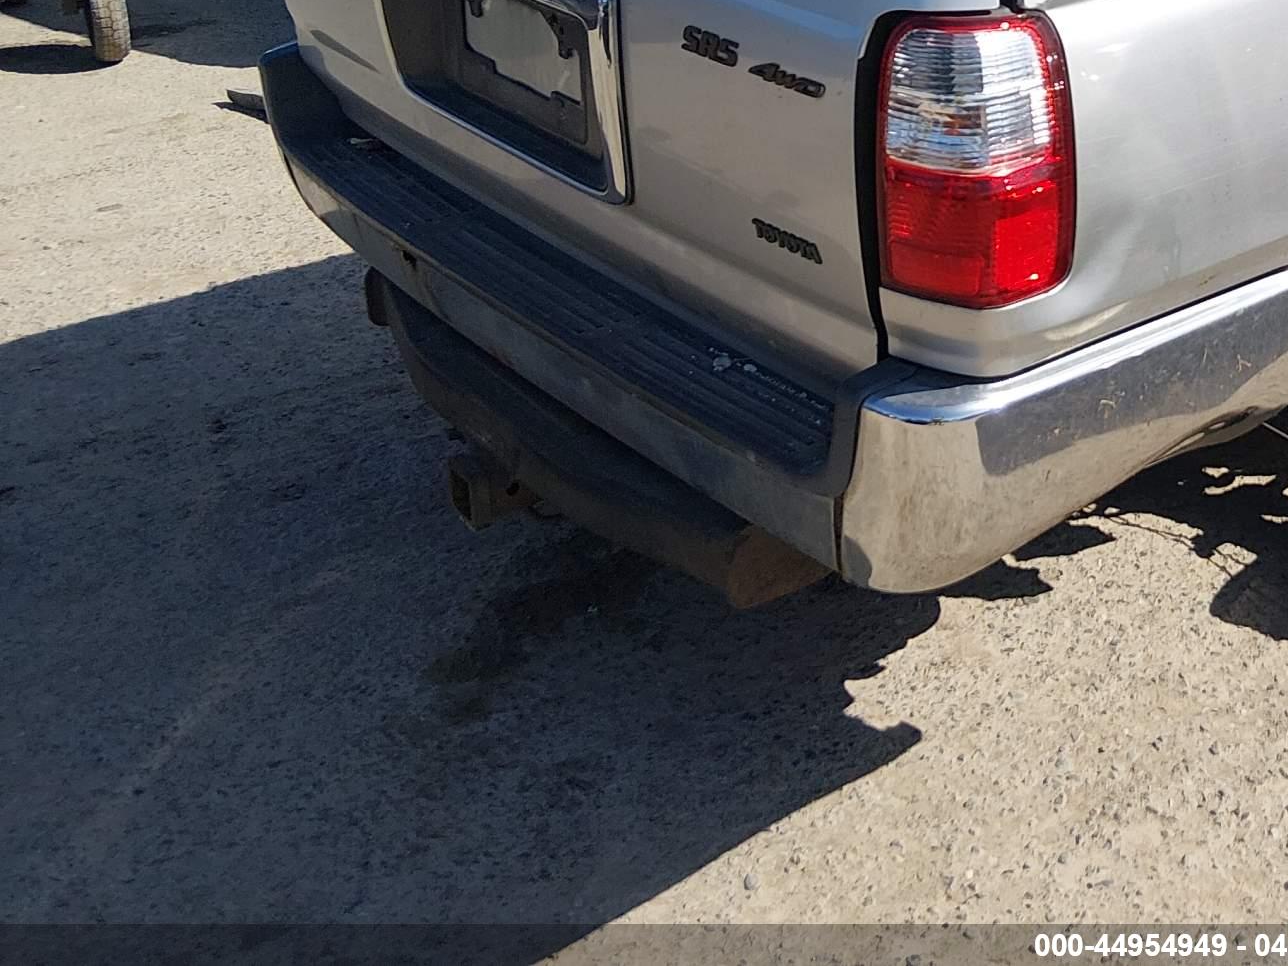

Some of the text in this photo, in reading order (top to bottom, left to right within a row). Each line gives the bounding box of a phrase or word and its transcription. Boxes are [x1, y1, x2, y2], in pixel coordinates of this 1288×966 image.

[681, 25, 827, 99] SR5 4WD
[751, 217, 824, 265] TOYOTA
